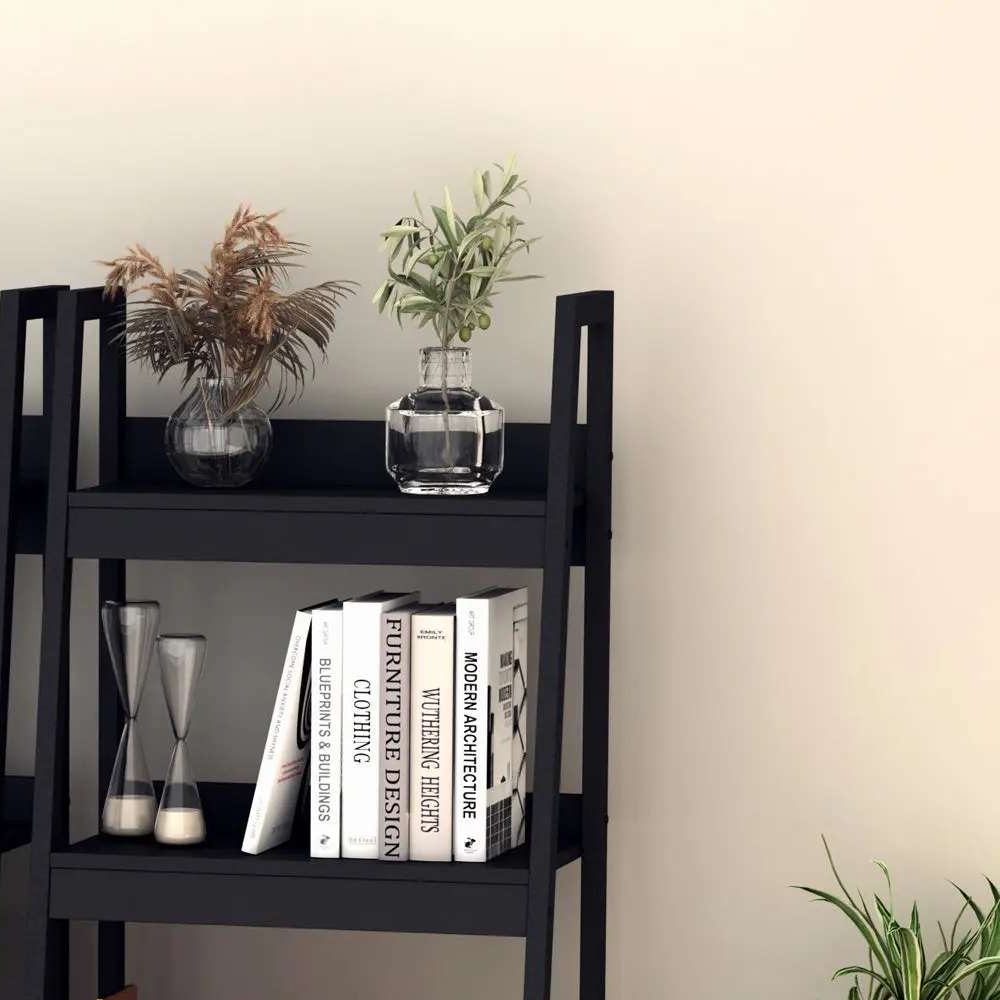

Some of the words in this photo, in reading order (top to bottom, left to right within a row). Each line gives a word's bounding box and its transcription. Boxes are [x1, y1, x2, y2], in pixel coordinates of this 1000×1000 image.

[319, 658, 331, 737] BLUEPRINTS
[353, 678, 371, 764] CLOTHING
[385, 618, 402, 761] FURNITURE
[464, 652, 478, 710] MODERN
[319, 741, 331, 750] &
[421, 687, 440, 770] WUTHERING
[463, 714, 477, 819] ARCHITECTURE
[318, 753, 331, 823] BUILDINGS
[384, 769, 402, 859] DESIGN
[420, 776, 439, 834] HEIGHTS
